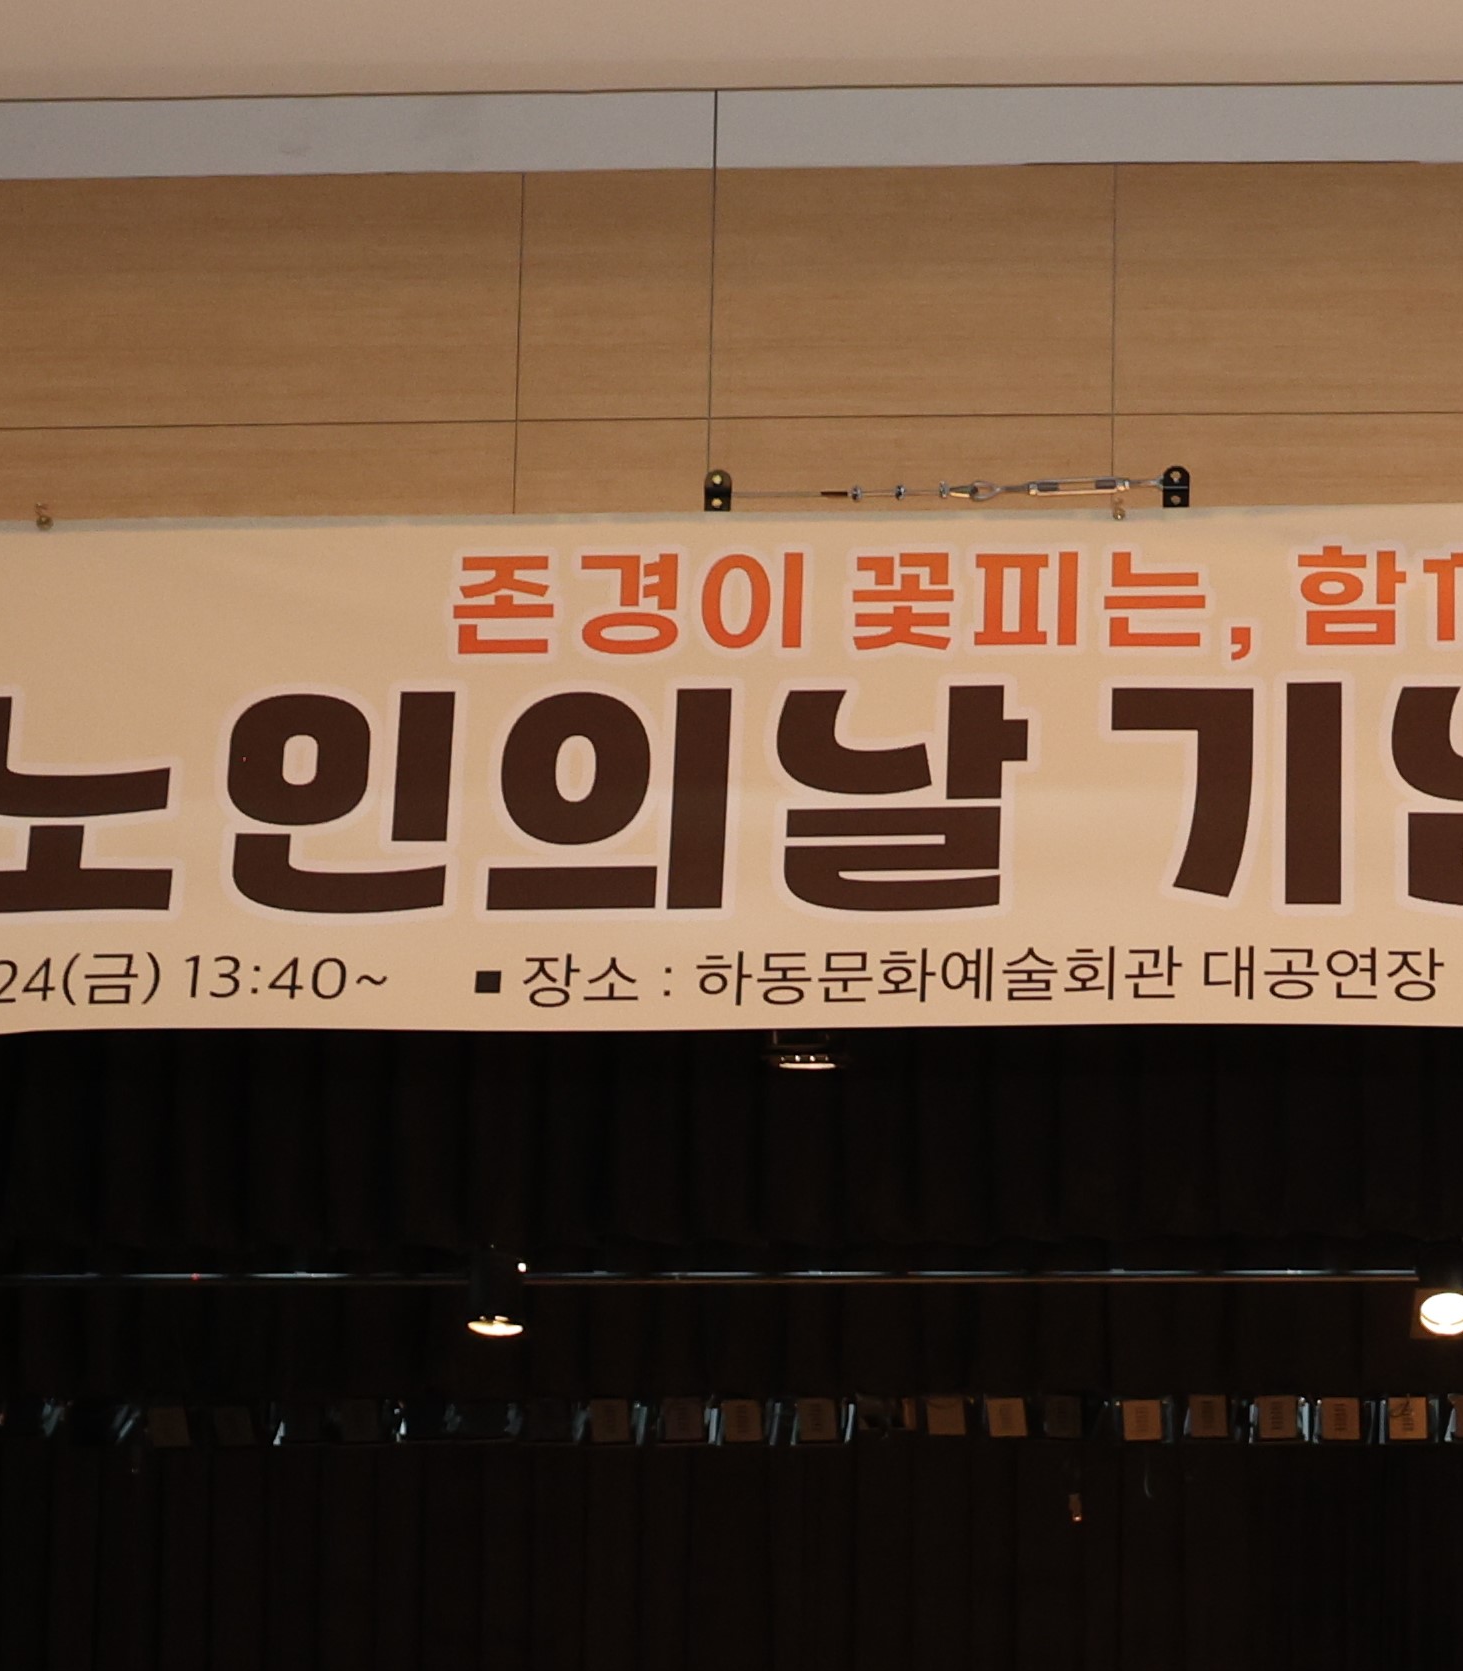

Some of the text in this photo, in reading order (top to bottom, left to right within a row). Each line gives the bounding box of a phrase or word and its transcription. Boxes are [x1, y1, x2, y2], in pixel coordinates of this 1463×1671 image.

[455, 553, 803, 654] 존경이
[854, 552, 1251, 659] 꽃피는,
[186, 956, 387, 999] 13:40~
[524, 954, 638, 1007] 장소
[697, 946, 1182, 1006] 하동문화예술회관
[1204, 946, 1444, 1001] 대공연장
